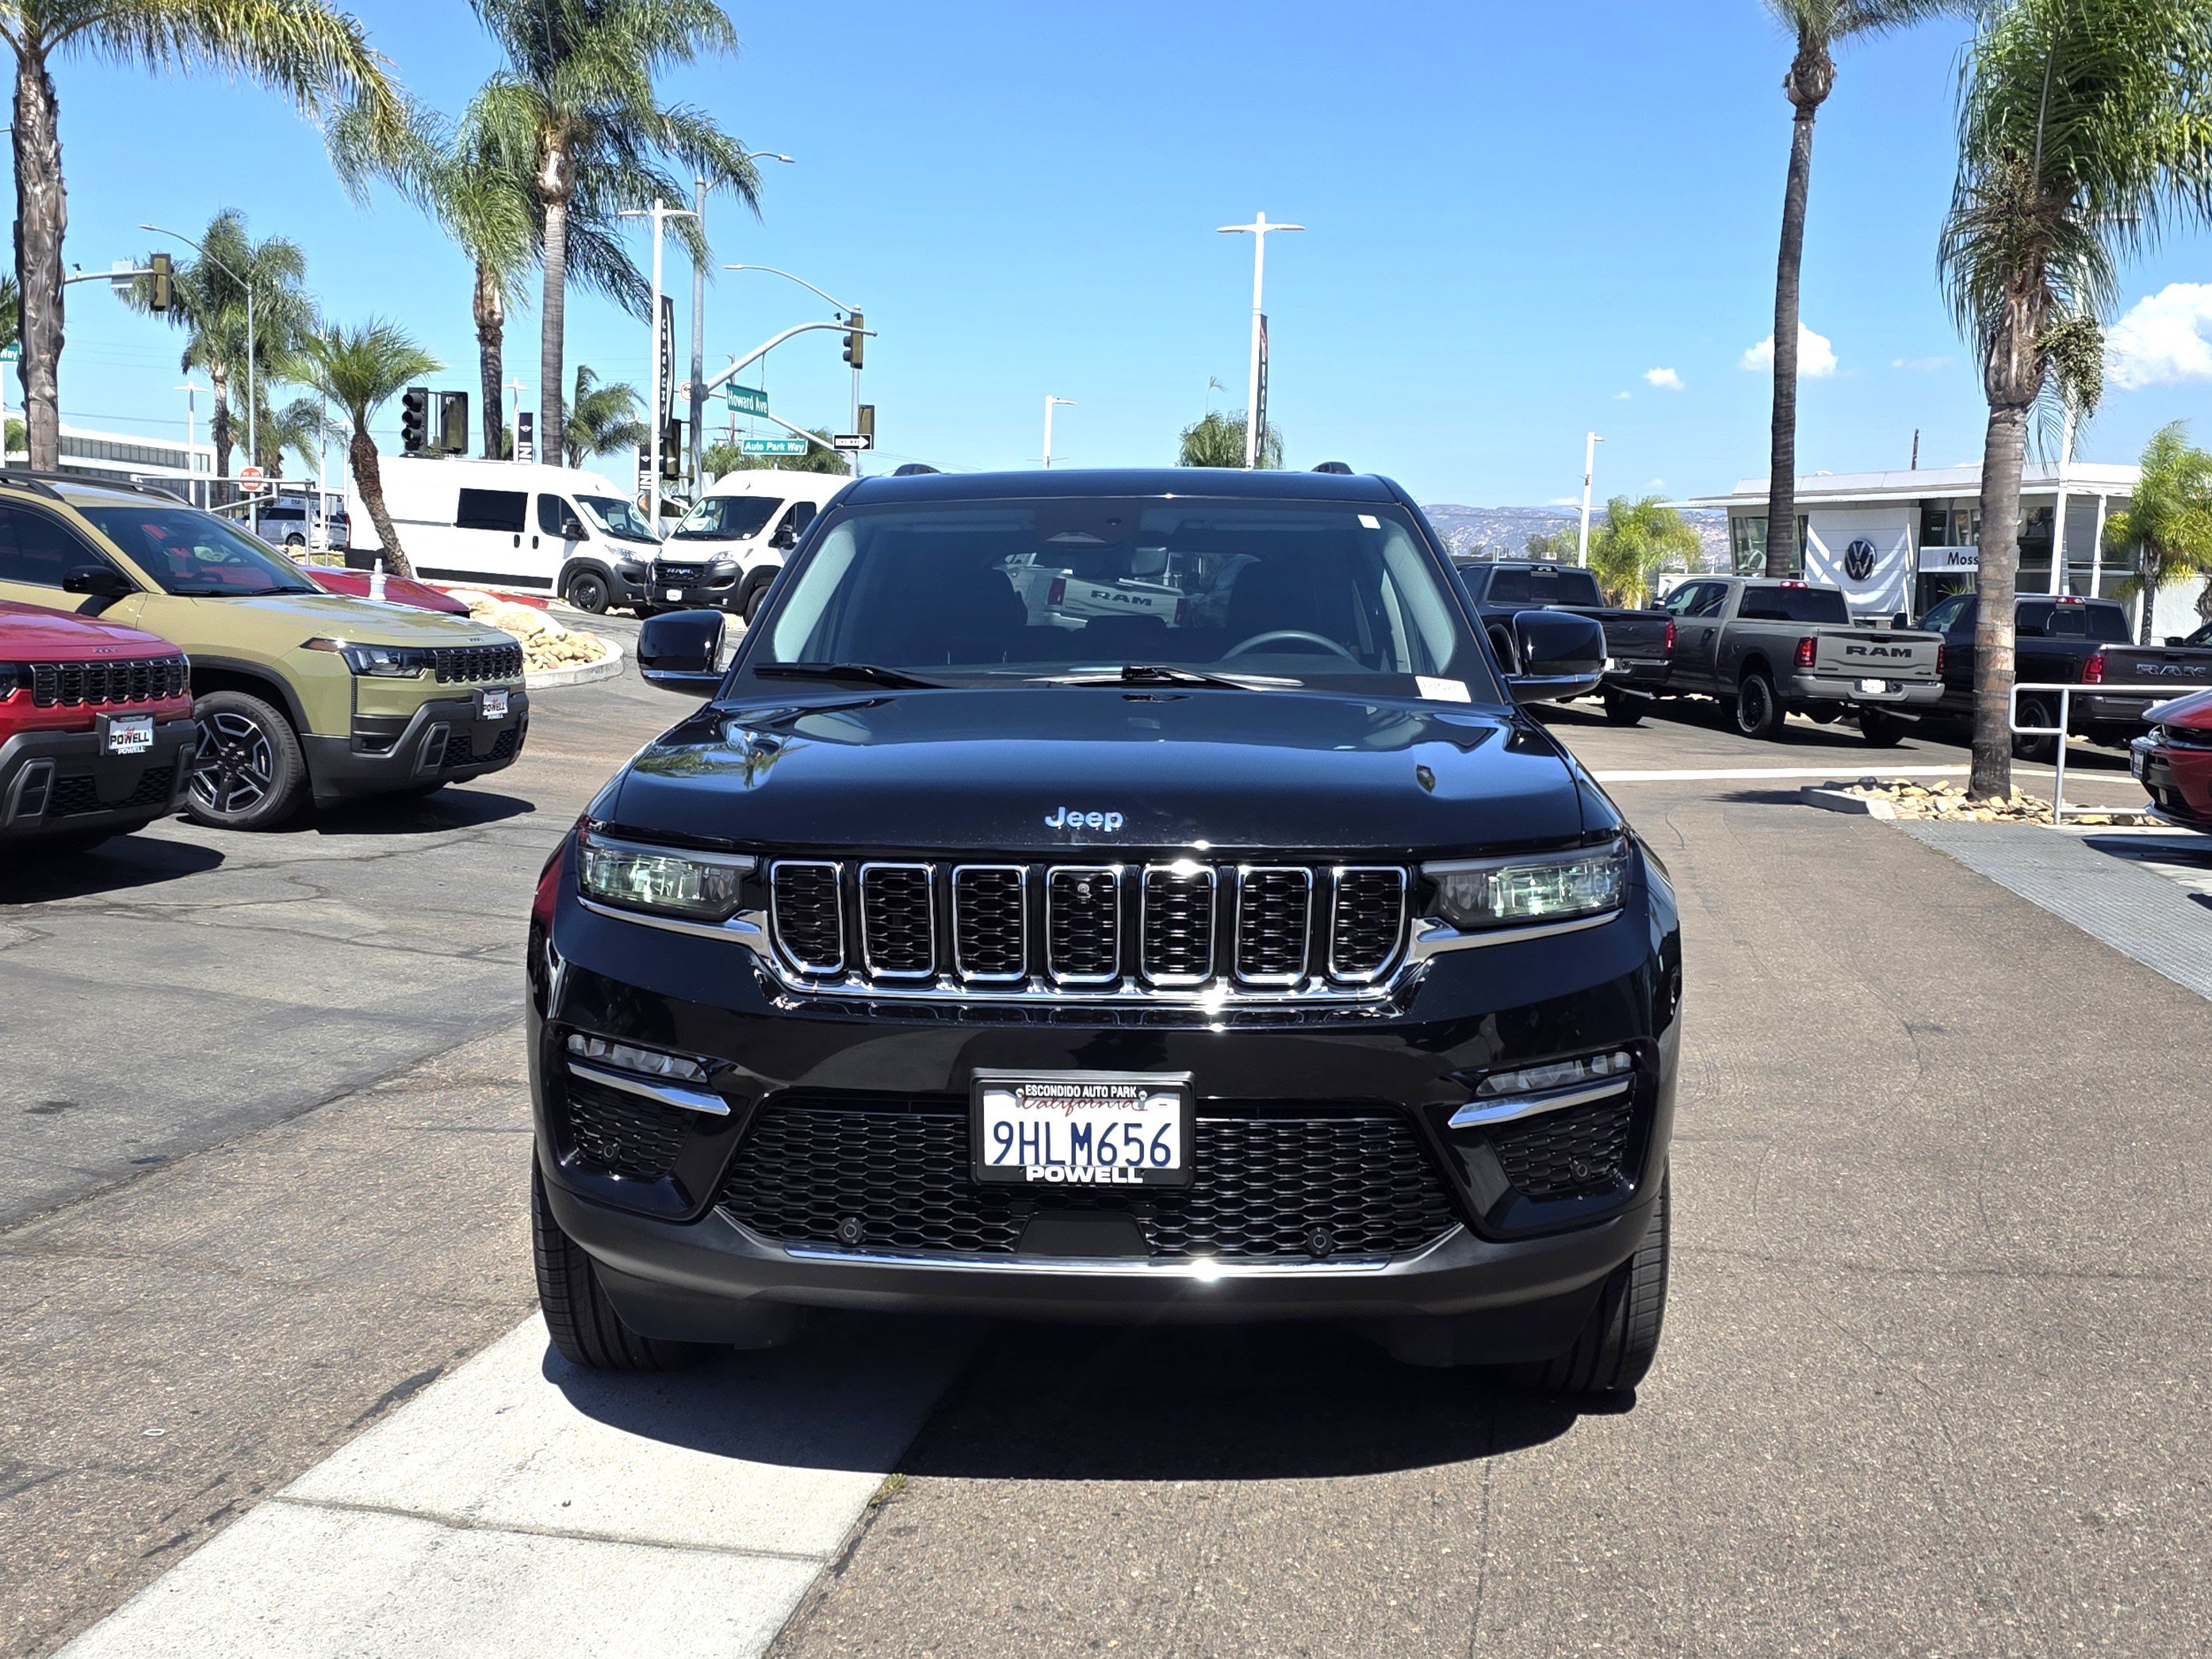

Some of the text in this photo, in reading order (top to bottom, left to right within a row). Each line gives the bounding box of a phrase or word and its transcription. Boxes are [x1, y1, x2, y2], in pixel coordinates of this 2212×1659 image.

[727, 389, 767, 414] Howard Ave
[744, 442, 805, 453] Auto Park Way
[1090, 590, 1152, 607] RAM
[1846, 645, 1912, 658] RAM
[2136, 663, 2206, 678] RAM
[110, 732, 149, 746] POWELL
[1045, 806, 1123, 832] Jeep
[1025, 1084, 1137, 1099] ESCONDIDO AUTO PARK
[1020, 1095, 1148, 1117] California
[993, 1121, 1172, 1167] 9HLM656
[1026, 1166, 1143, 1183] POWELL
